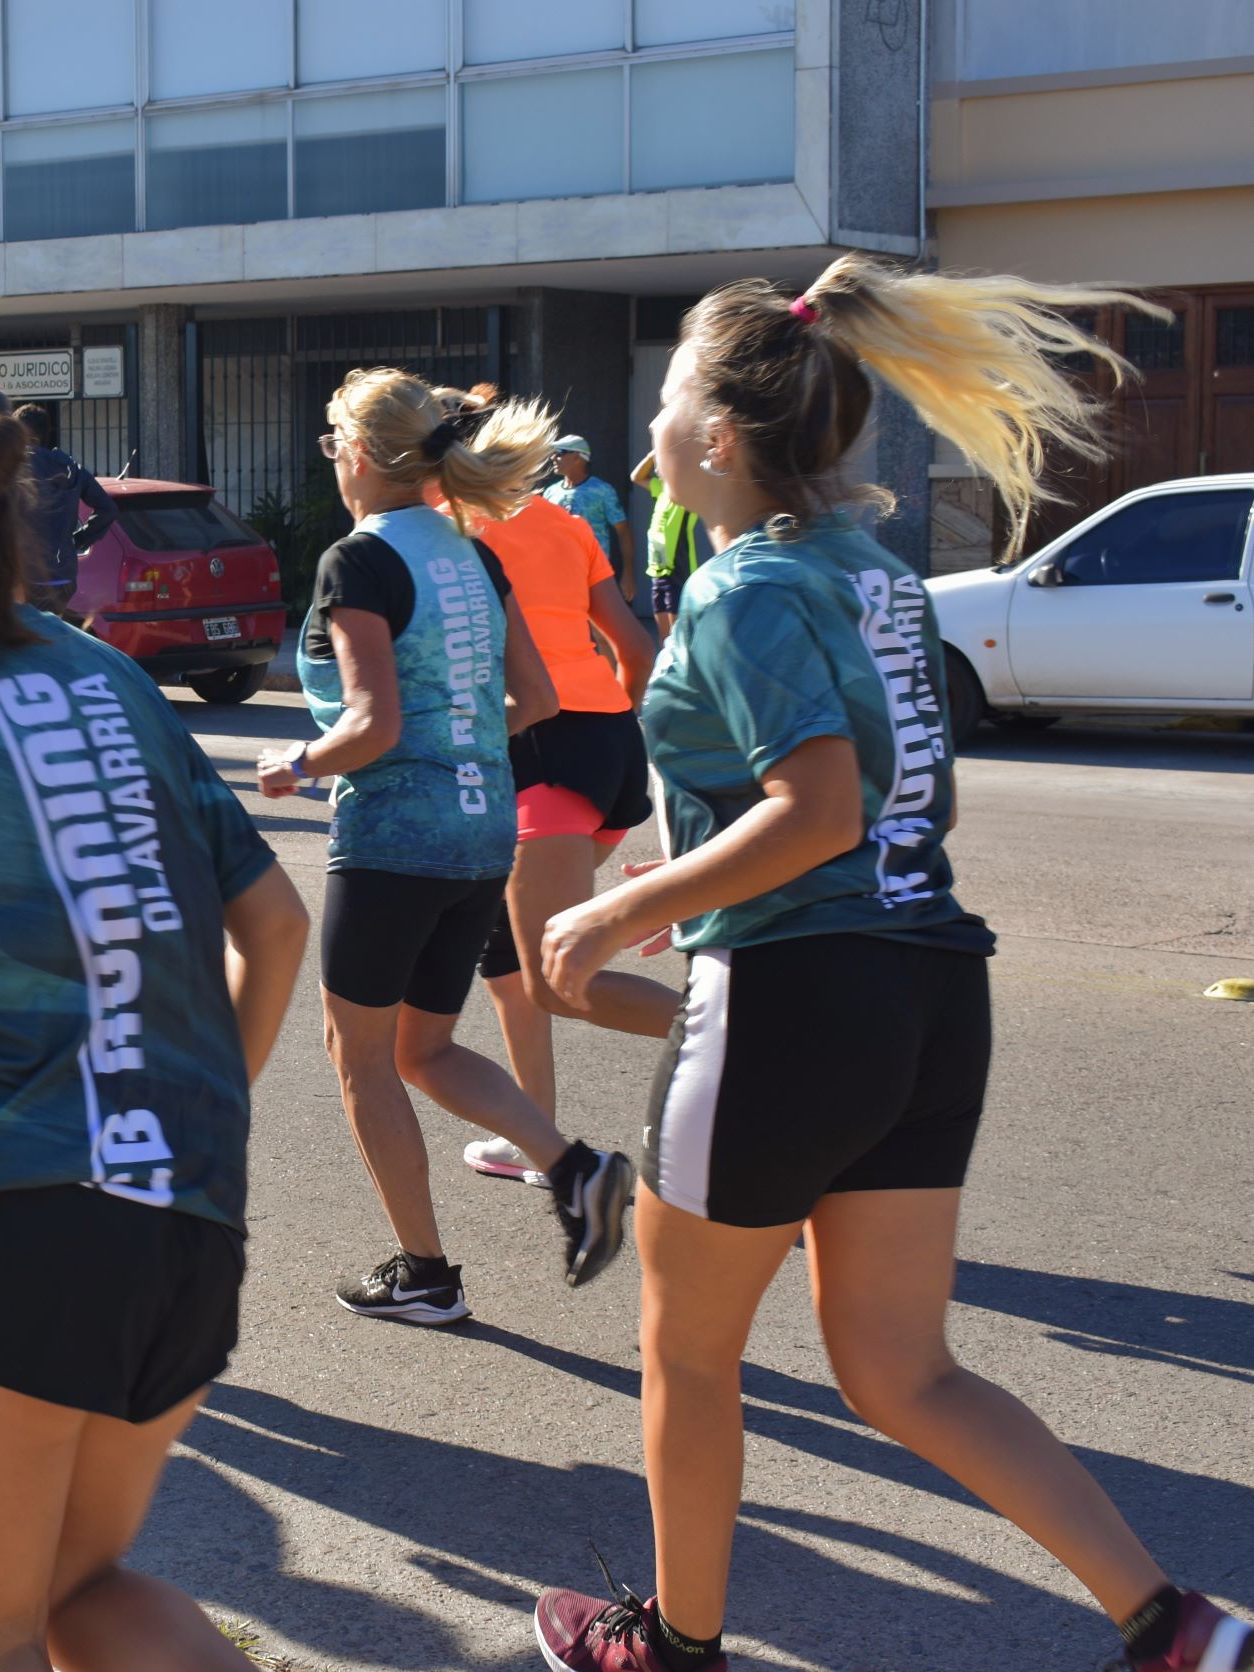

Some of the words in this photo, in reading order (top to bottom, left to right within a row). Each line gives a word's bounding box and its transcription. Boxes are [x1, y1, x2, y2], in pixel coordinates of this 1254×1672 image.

[10, 360, 71, 378] JURIDICO
[14, 379, 69, 390] ASOCIADOS
[426, 557, 479, 746] RUNNING
[457, 559, 492, 685] OLAVARRIA
[68, 672, 184, 932] OLAVARRIA
